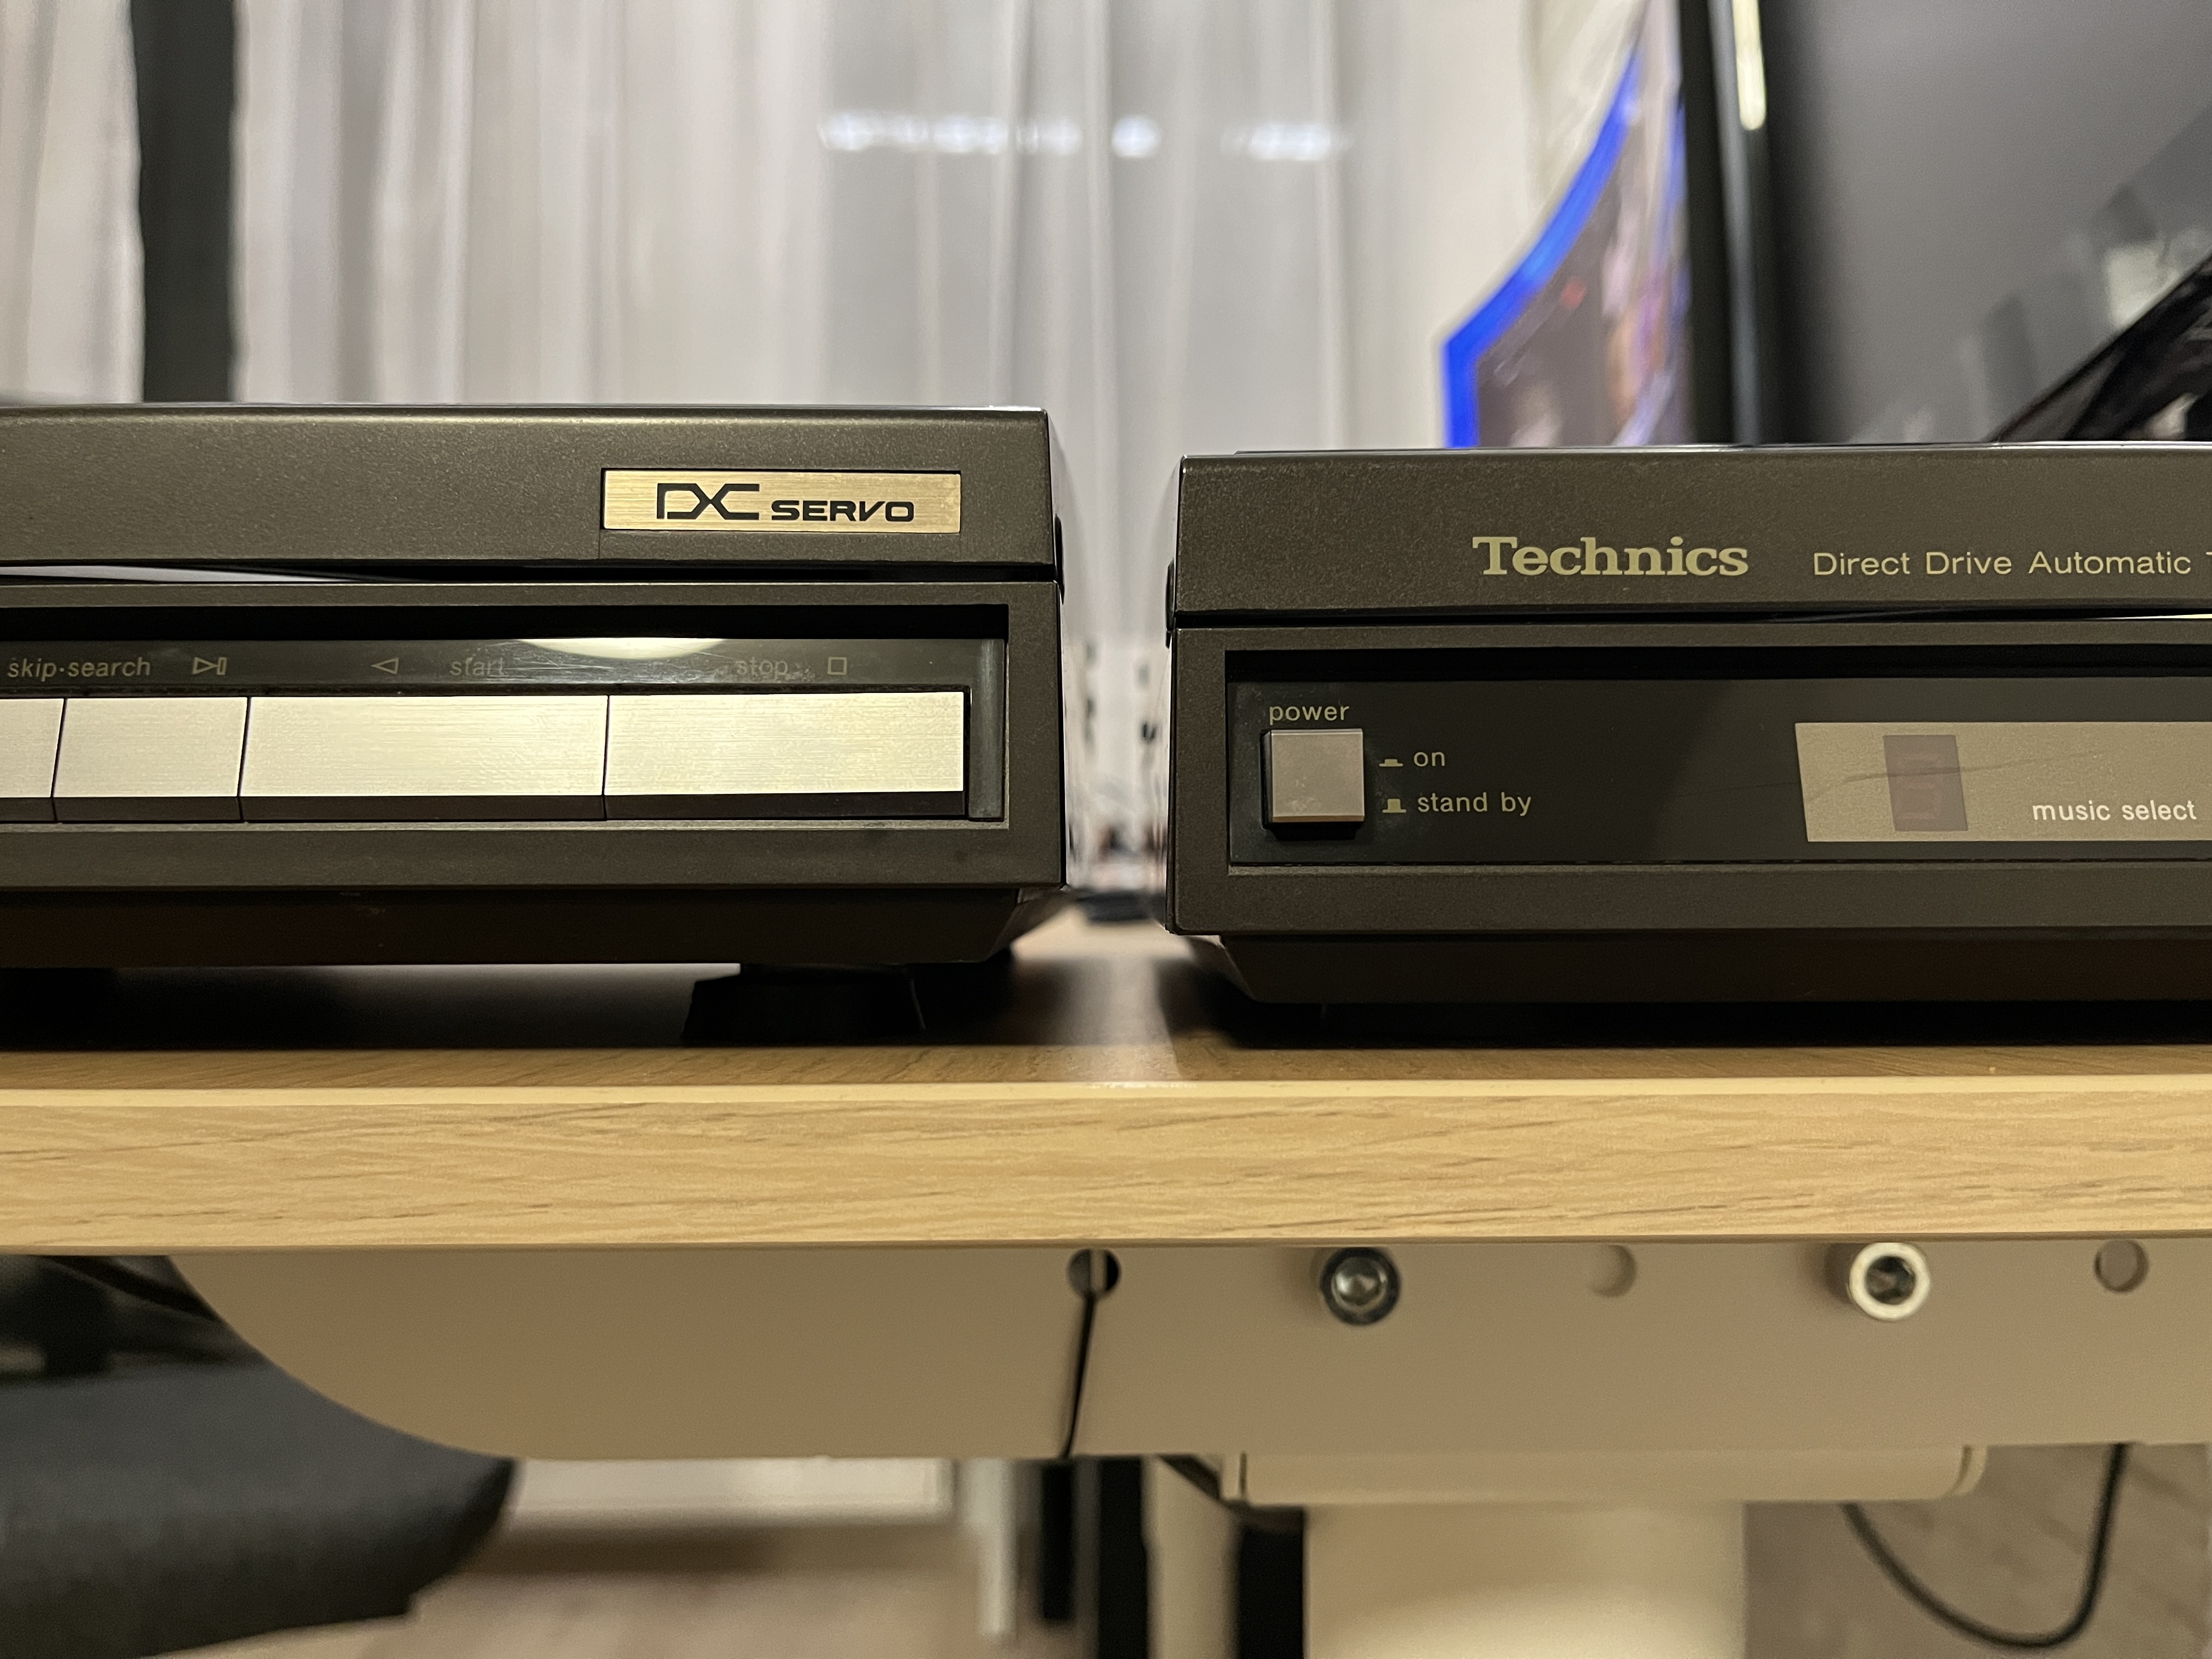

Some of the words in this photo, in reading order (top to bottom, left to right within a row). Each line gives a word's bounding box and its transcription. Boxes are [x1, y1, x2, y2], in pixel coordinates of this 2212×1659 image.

[771, 500, 914, 522] SERVO
[1472, 537, 1748, 575] Technics
[1814, 553, 1910, 575] Direct
[1927, 552, 2011, 574] Drive
[2029, 551, 2191, 574] Automatic
[450, 658, 504, 675] start
[736, 657, 788, 681] stop
[1269, 706, 1349, 725] power
[1413, 752, 1445, 767] on
[1418, 792, 1487, 812] stand
[1502, 792, 1531, 816] by
[2033, 800, 2111, 820] music
[2122, 800, 2197, 820] select
